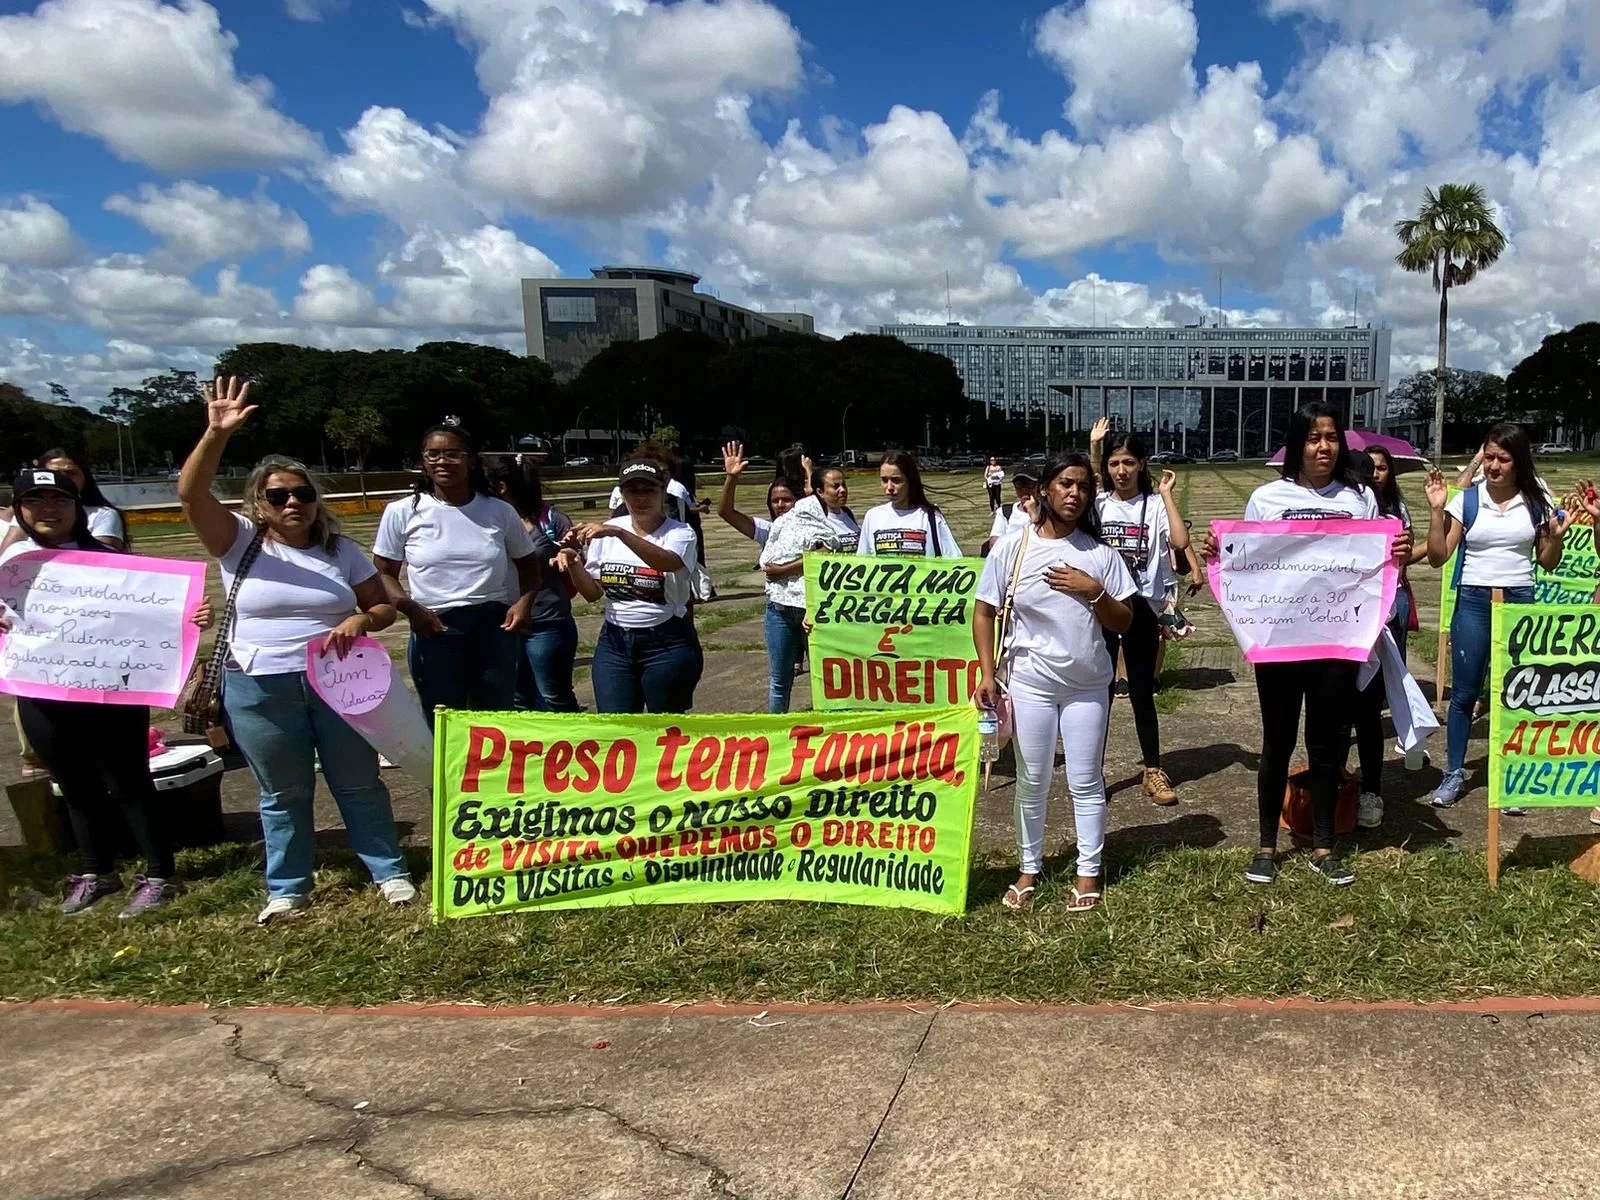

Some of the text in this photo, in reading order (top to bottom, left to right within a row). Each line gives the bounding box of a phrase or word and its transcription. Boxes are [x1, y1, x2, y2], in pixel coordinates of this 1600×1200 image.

[623, 463, 656, 475] adidas
[876, 532, 902, 541] JUSTIÇA
[602, 563, 634, 575] JUSTIÇA
[818, 560, 977, 595] VISITA NÃO
[70, 584, 175, 605] violando
[1326, 591, 1348, 604] 30
[27, 601, 112, 619] nossos
[835, 595, 968, 626] REGALIA
[160, 640, 178, 650] a
[323, 660, 373, 688] Sem
[460, 725, 639, 794] Preso
[655, 726, 767, 794] tem
[452, 799, 636, 841] Exigimos
[803, 783, 937, 823] Direito
[453, 842, 491, 872] de
[501, 838, 612, 871] VISITA,
[615, 824, 778, 860] QUEREMOS
[823, 819, 936, 853] DIREITO
[452, 875, 506, 907] Das
[516, 863, 615, 902] Visitas
[796, 849, 945, 896] Regularidade
